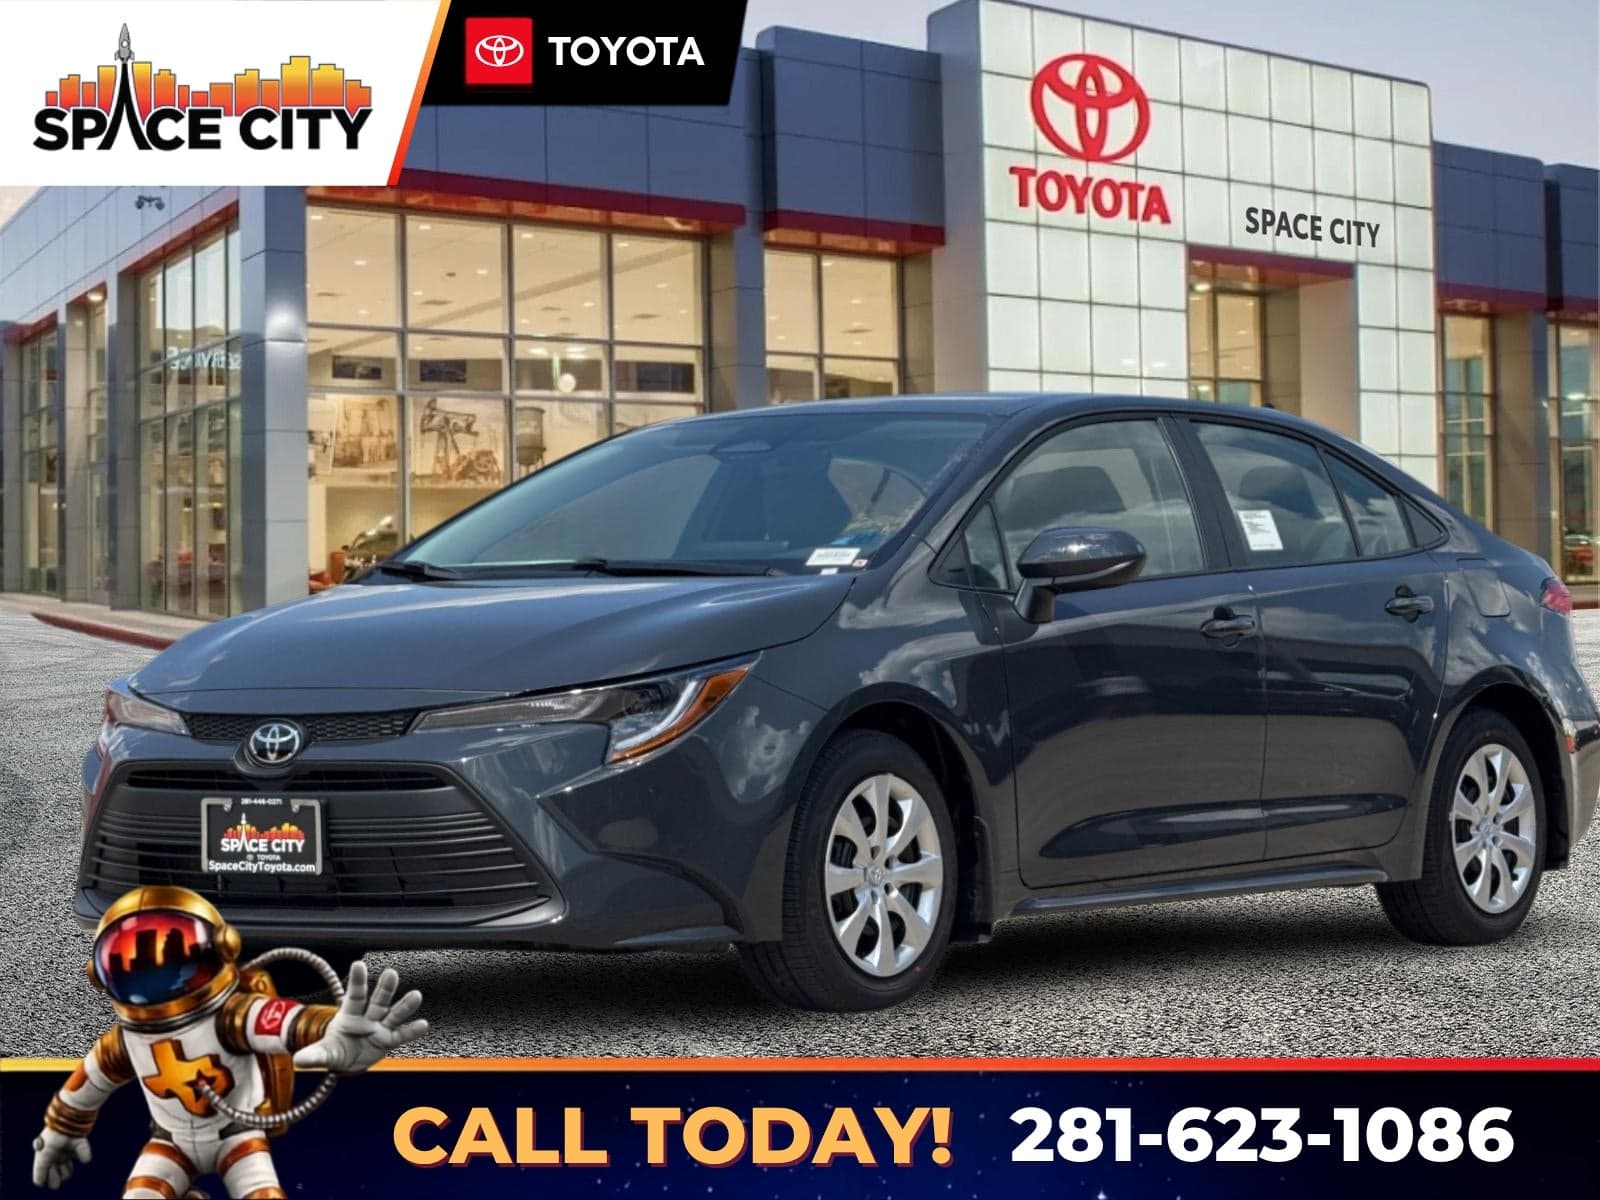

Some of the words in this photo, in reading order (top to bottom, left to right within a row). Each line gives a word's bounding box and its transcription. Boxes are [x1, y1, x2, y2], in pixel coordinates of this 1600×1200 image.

[1009, 166, 1171, 224] TOYOTA
[1245, 207, 1322, 242] SPACE
[1329, 217, 1381, 248] CITY
[220, 838, 268, 852] SPACE
[271, 838, 305, 852] CITY
[208, 860, 316, 875] SpaceCityToyota.com
